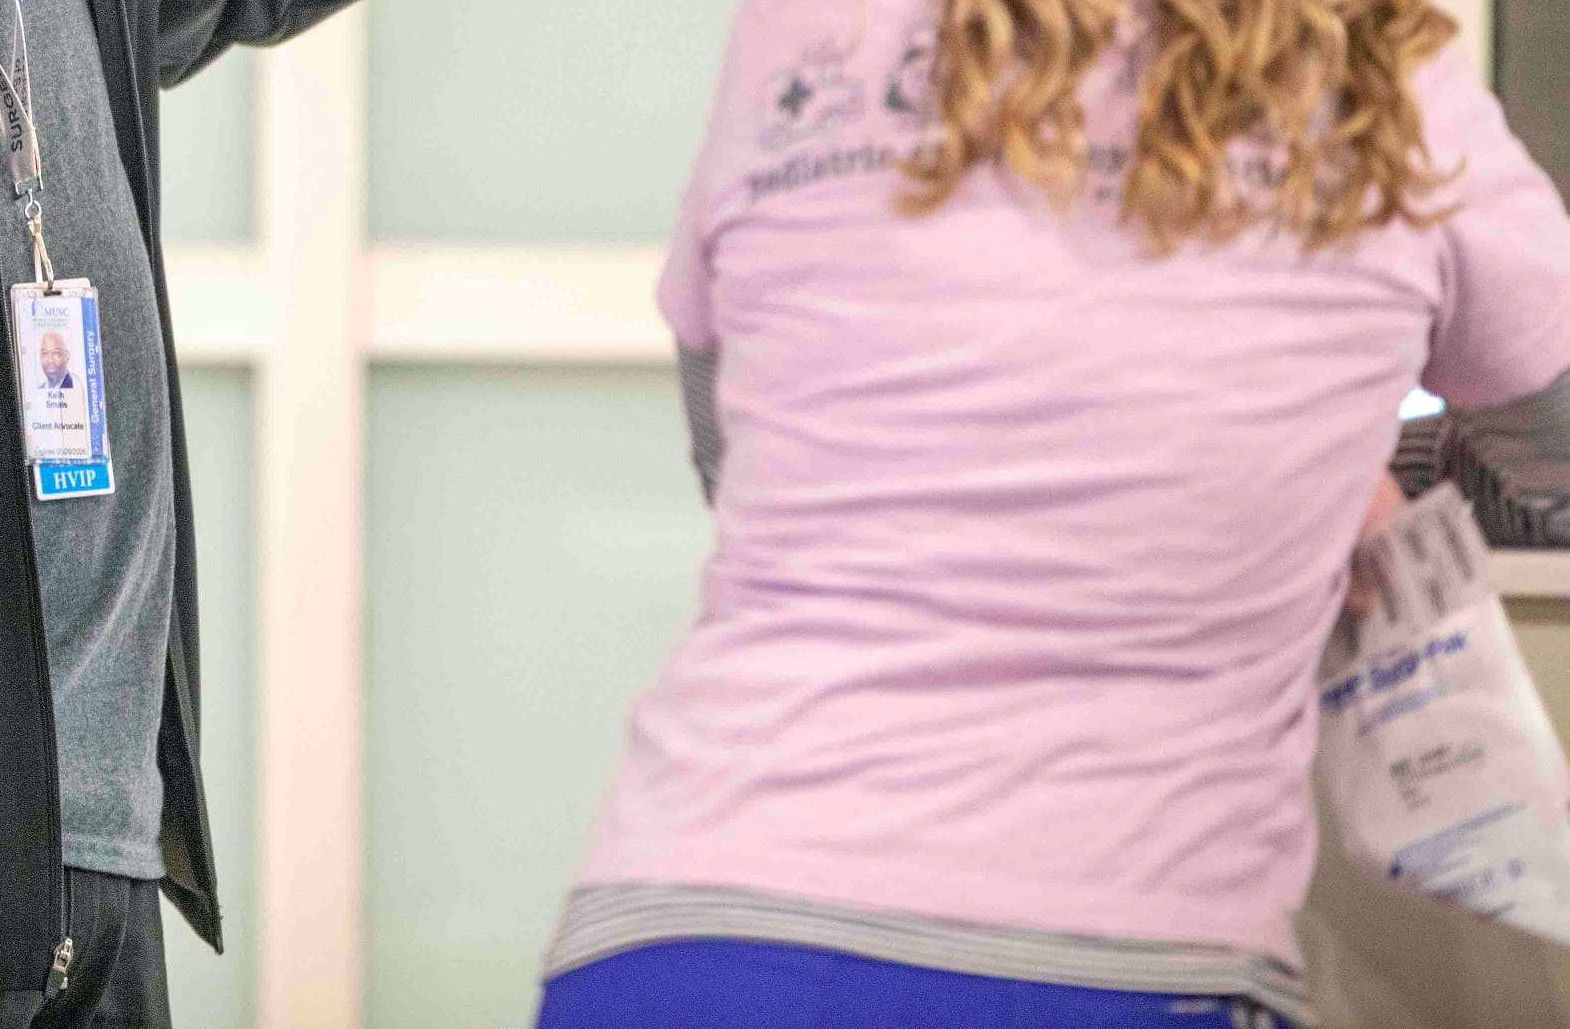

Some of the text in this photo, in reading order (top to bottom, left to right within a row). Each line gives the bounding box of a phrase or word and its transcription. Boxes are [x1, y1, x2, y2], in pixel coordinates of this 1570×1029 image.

[87, 331, 100, 424] General Surgery
[32, 421, 84, 430] Client Advocate
[53, 469, 96, 490] HVIP
